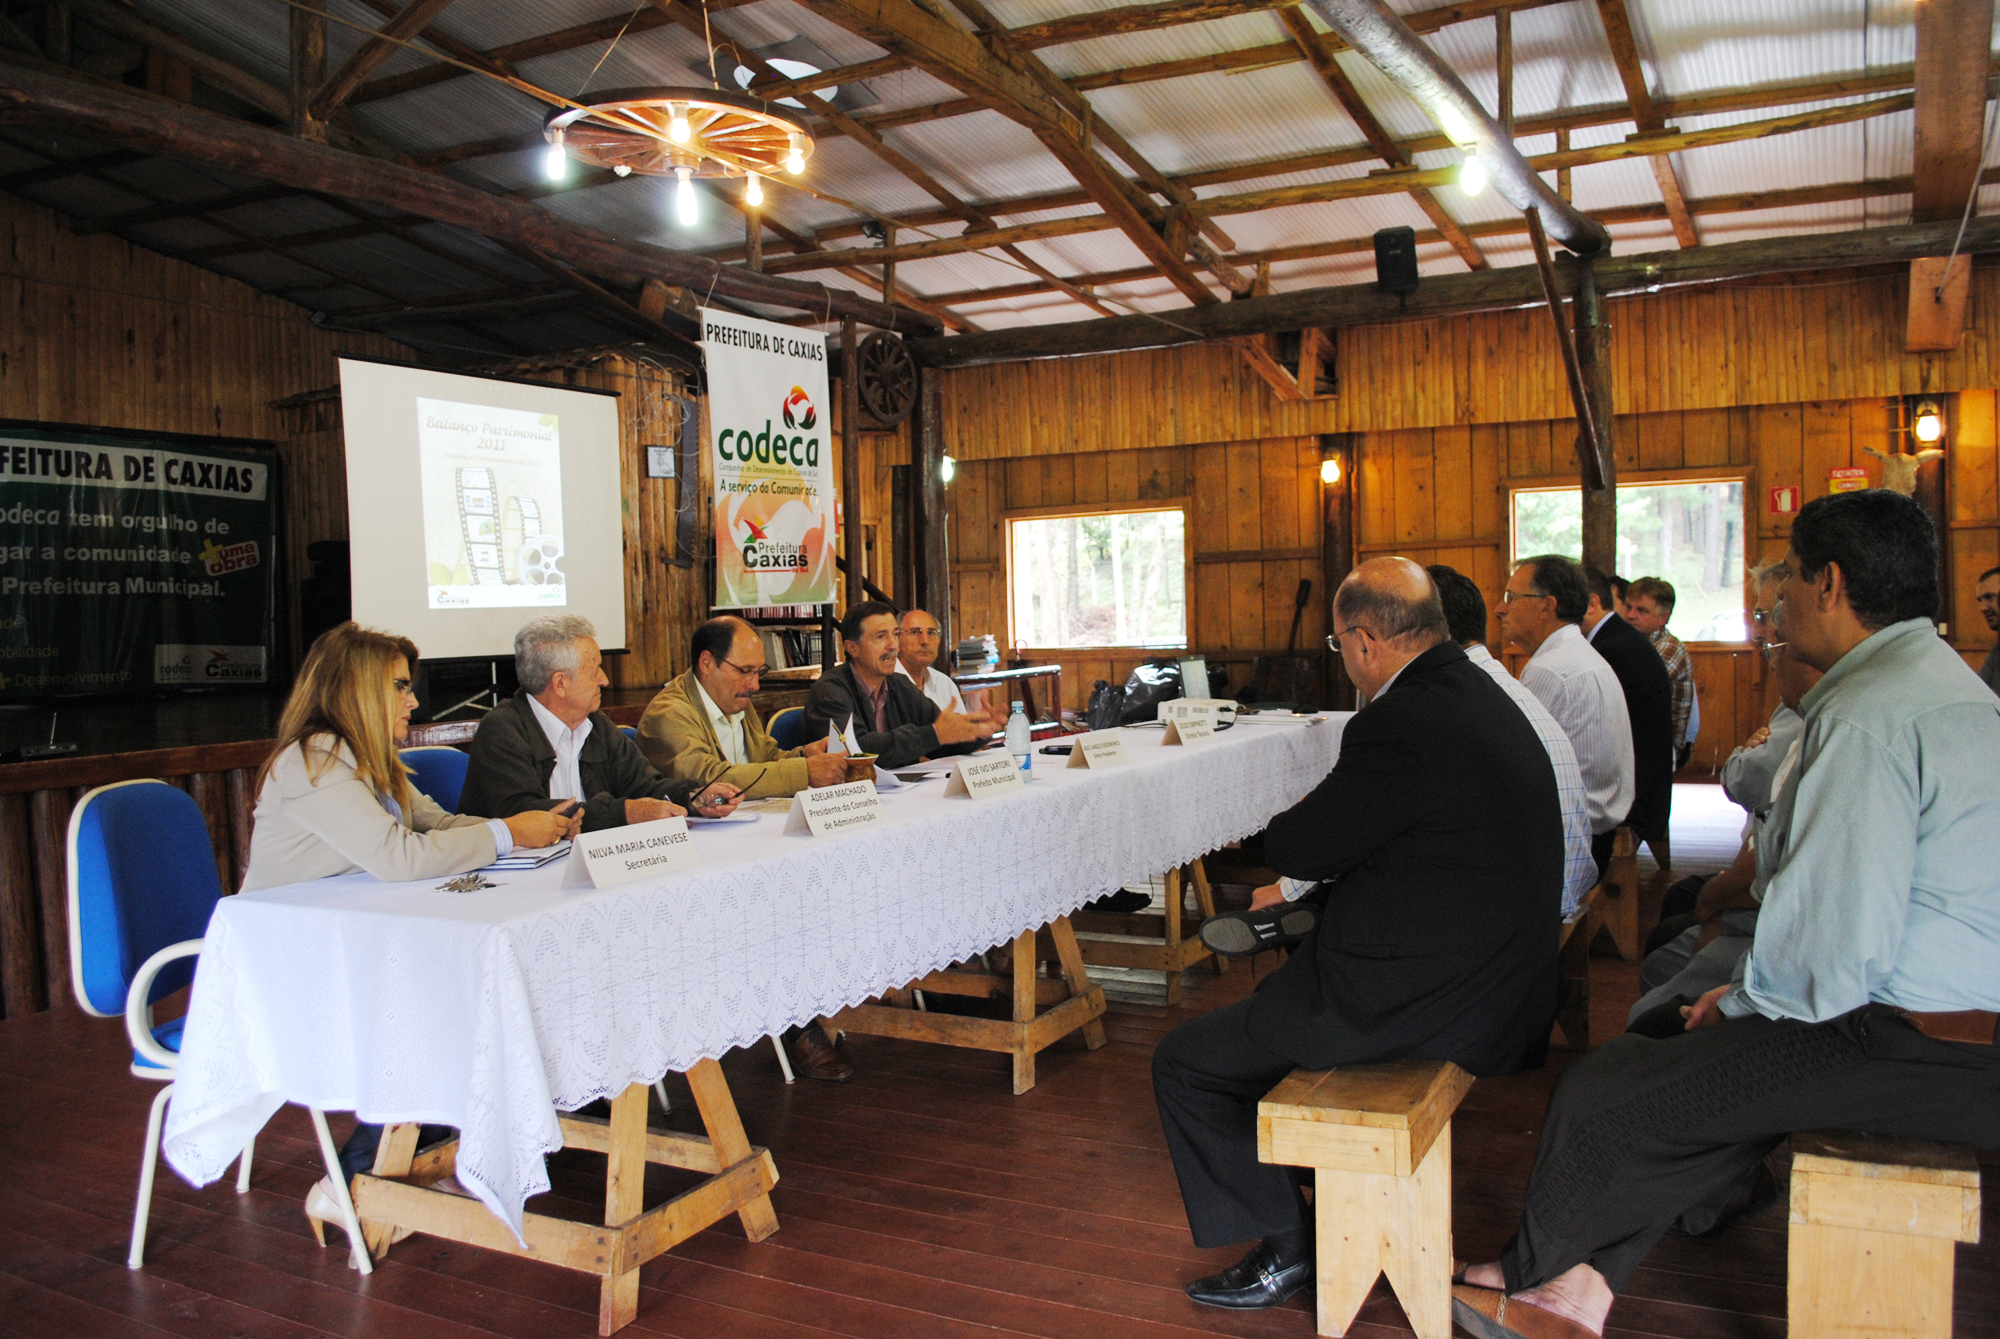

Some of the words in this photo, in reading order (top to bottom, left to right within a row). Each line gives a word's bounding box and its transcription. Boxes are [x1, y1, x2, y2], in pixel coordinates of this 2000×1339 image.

[706, 323, 770, 352] PREFEITURA
[773, 336, 785, 355] DE
[788, 339, 823, 361] CAXIAS
[426, 416, 478, 435] Balanço
[482, 422, 553, 441] Patrimonial
[476, 437, 506, 451] 2011
[718, 419, 819, 467] codeca
[0, 446, 113, 480] FEITURA
[124, 455, 155, 483] DE
[165, 458, 253, 493] CAXIAS
[720, 479, 726, 491] A
[728, 480, 758, 496] serviço
[760, 481, 769, 493] da
[71, 512, 114, 528] tem
[121, 513, 198, 533] orgulho
[204, 517, 230, 534] de
[41, 547, 55, 560] a
[63, 545, 192, 564] comunidade
[219, 542, 256, 559] uma
[743, 545, 808, 568] Caxias
[759, 542, 807, 554] Prefeitura
[209, 553, 258, 574] obra
[2, 577, 120, 595] Prefeitura
[126, 577, 226, 599] Municipal.
[15, 670, 132, 687] Desenvolvimento
[205, 664, 262, 677] Caxias
[967, 764, 980, 776] JOSÉ
[980, 764, 990, 774] IVO
[989, 760, 1011, 771] SARTORI
[972, 779, 993, 789] Prefeito
[991, 773, 1016, 785] Municipal
[811, 791, 835, 802] ADELAR
[834, 785, 867, 797] MACHADO
[809, 804, 842, 818] Presidente
[842, 803, 850, 811] do
[850, 798, 878, 809] Conselho
[824, 821, 833, 830] de
[833, 812, 876, 827] Administração
[588, 846, 615, 859] NILVA
[615, 841, 646, 854] MARIA
[646, 832, 689, 848] CANEVESE
[625, 853, 668, 870] Secretária
